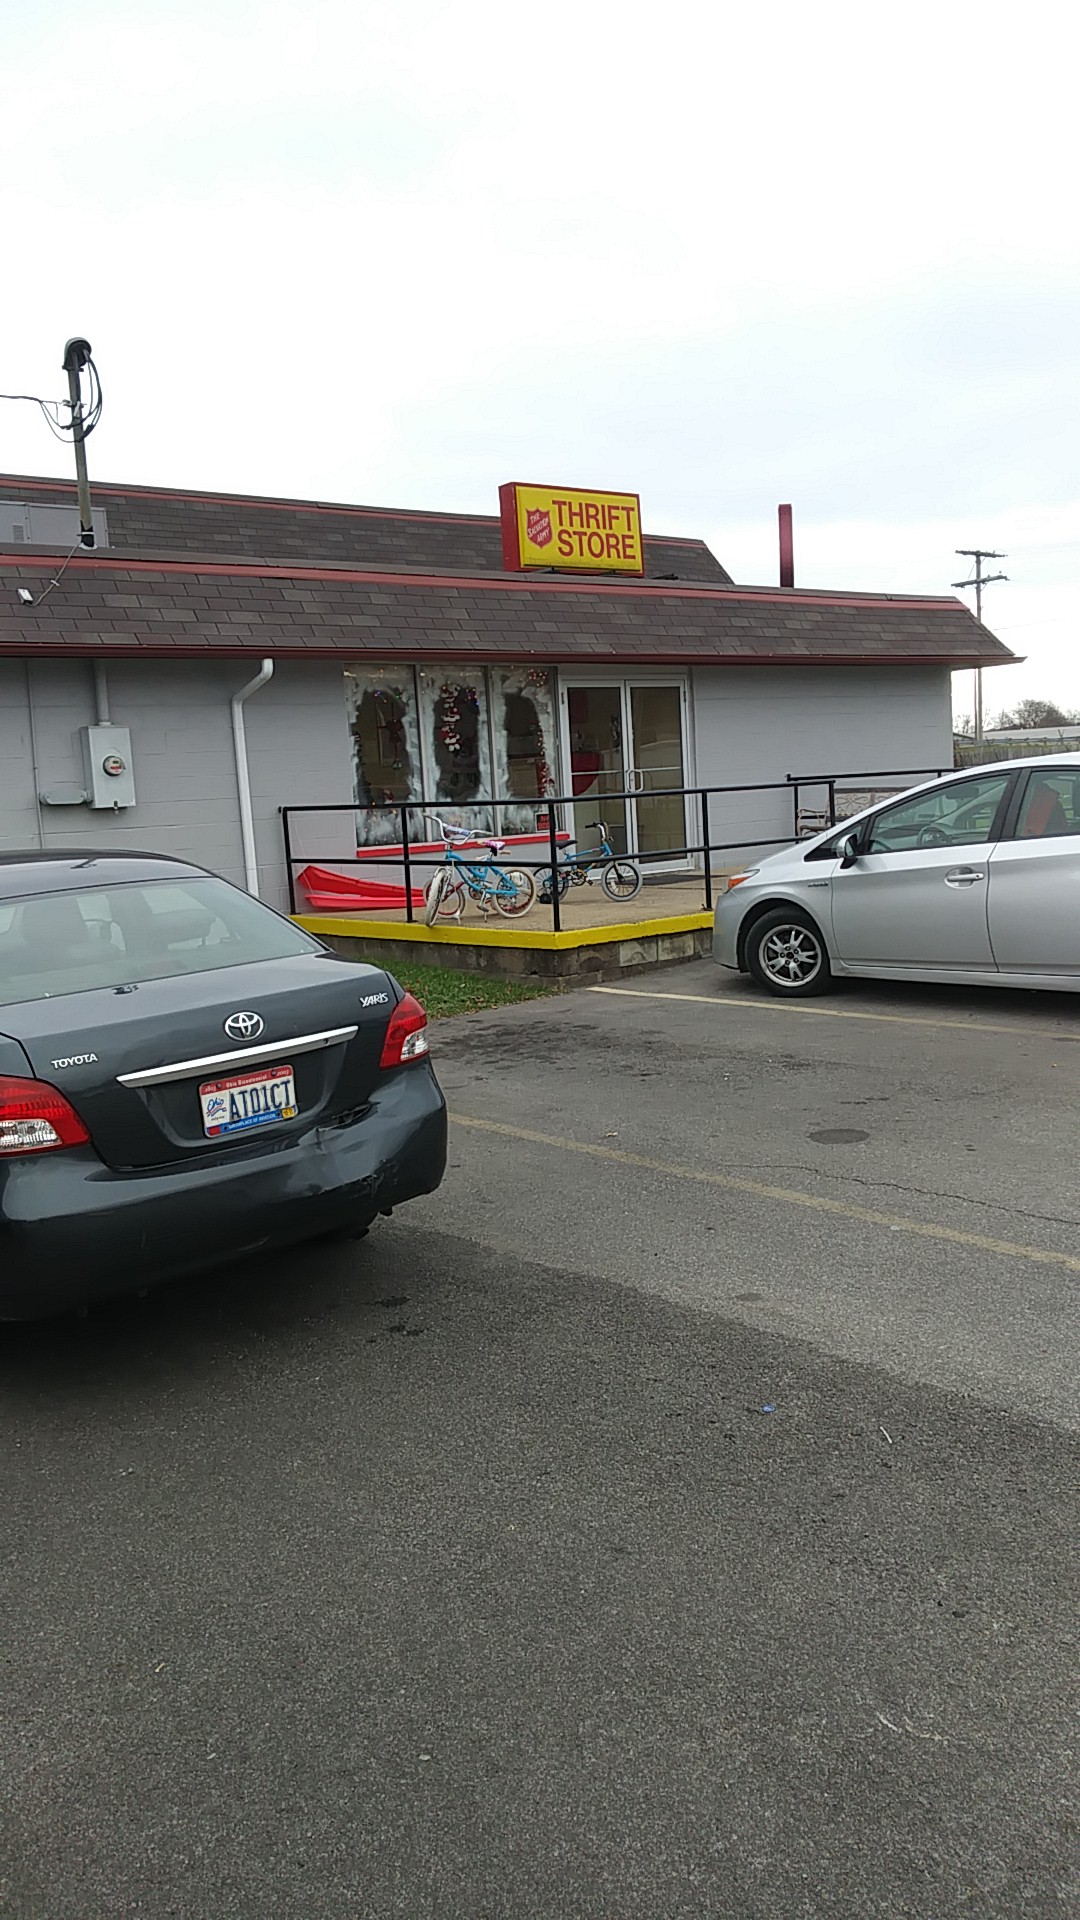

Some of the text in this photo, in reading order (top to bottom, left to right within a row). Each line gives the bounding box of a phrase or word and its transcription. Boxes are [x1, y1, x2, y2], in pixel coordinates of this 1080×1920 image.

[530, 512, 540, 524] THE
[552, 500, 635, 531] THRIFT
[537, 527, 550, 543] ARMY
[557, 529, 636, 559] STORE
[360, 992, 388, 1007] YARIS
[51, 1053, 98, 1069] TOYOTA
